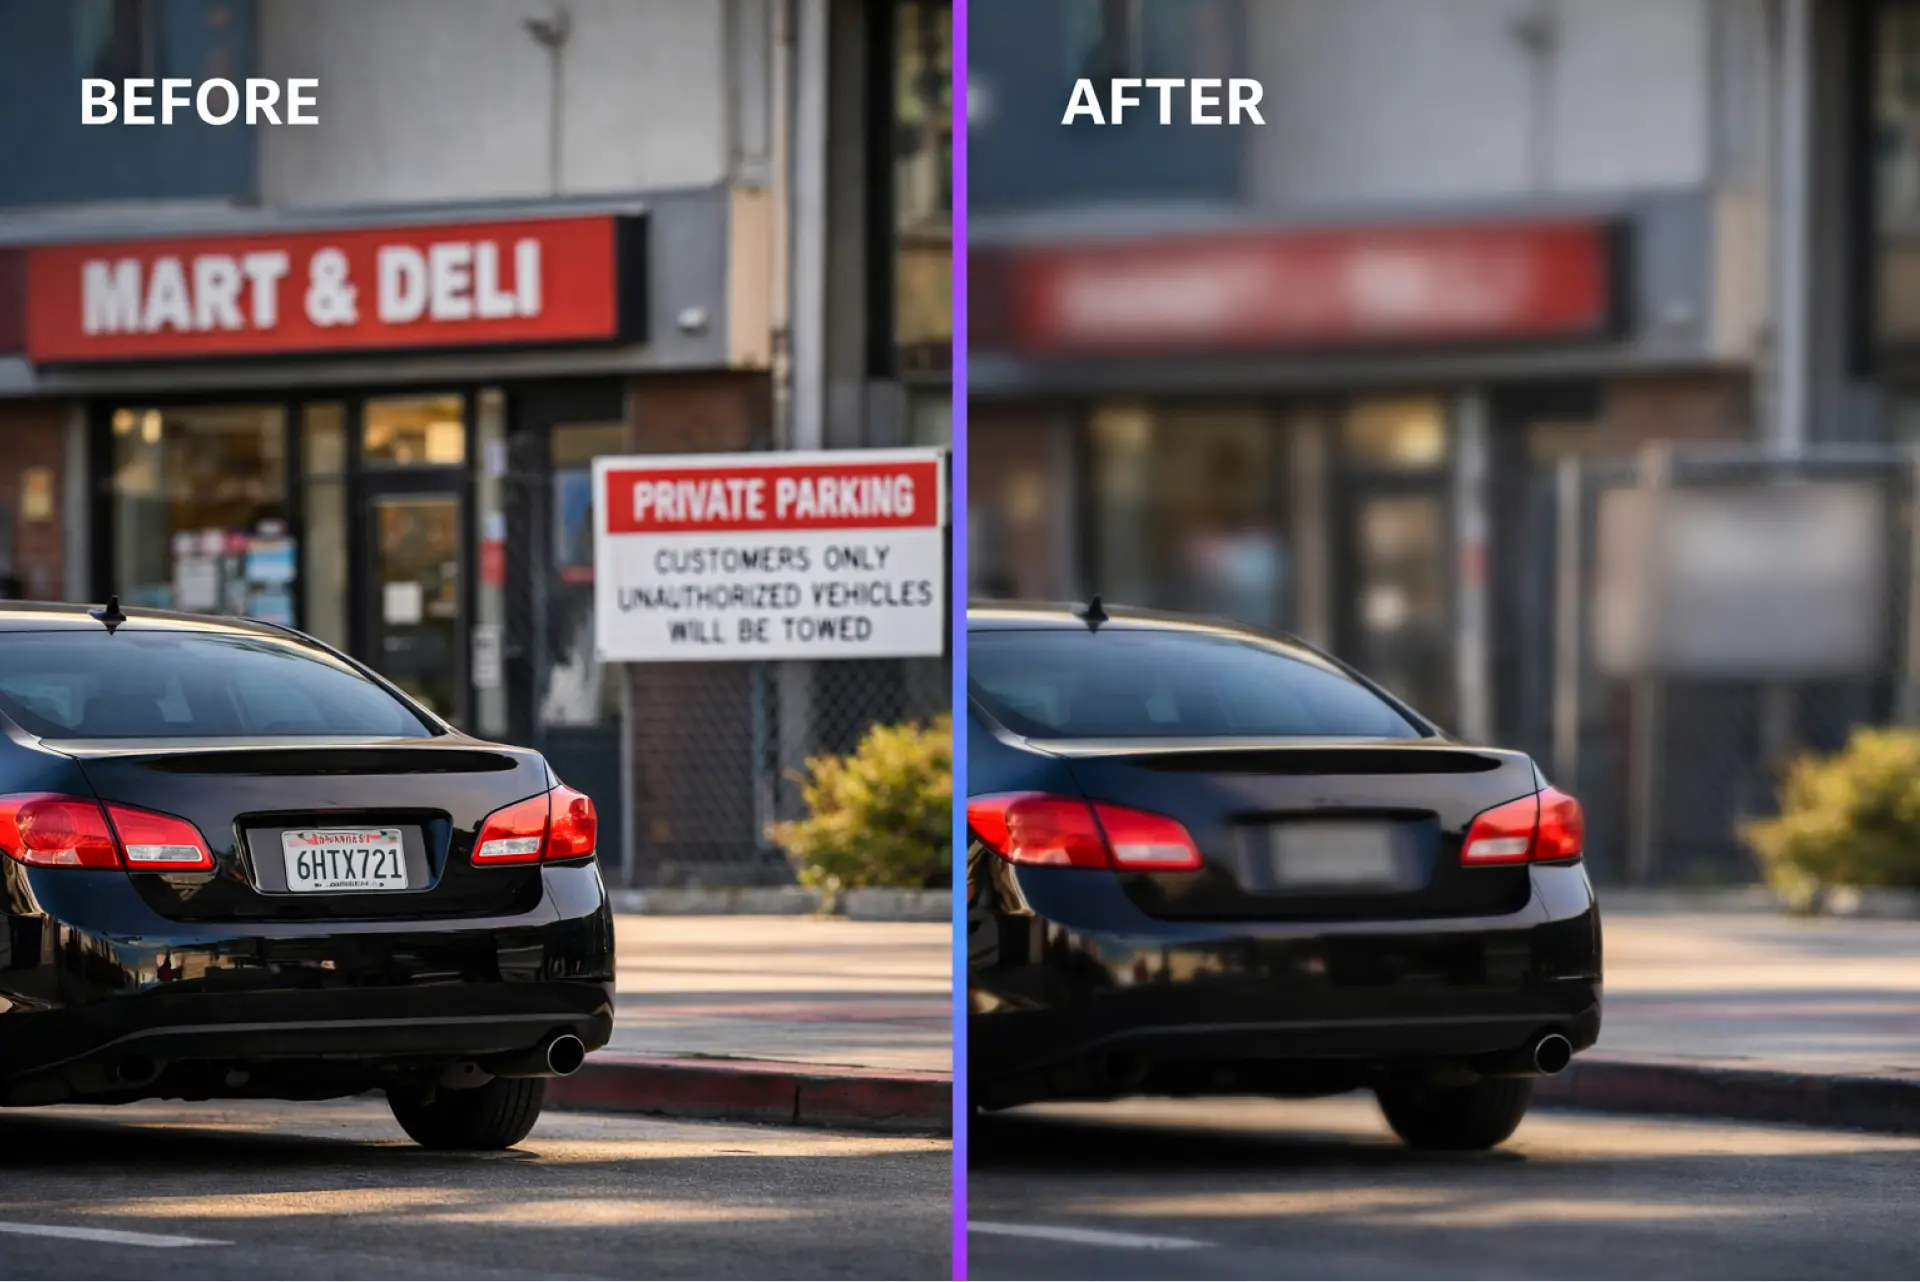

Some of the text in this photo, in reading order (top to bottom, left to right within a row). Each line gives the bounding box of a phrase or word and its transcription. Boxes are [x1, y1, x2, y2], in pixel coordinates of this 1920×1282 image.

[82, 239, 542, 335] MART & DELI
[634, 474, 915, 521] PRIVATE PARKING
[653, 545, 891, 575] CUSTOMERS ONLY
[617, 579, 933, 613] UNAUTHORIZED VEHICLES
[669, 616, 873, 644] WILL BE TOWED
[297, 848, 402, 880] 6HTX721
